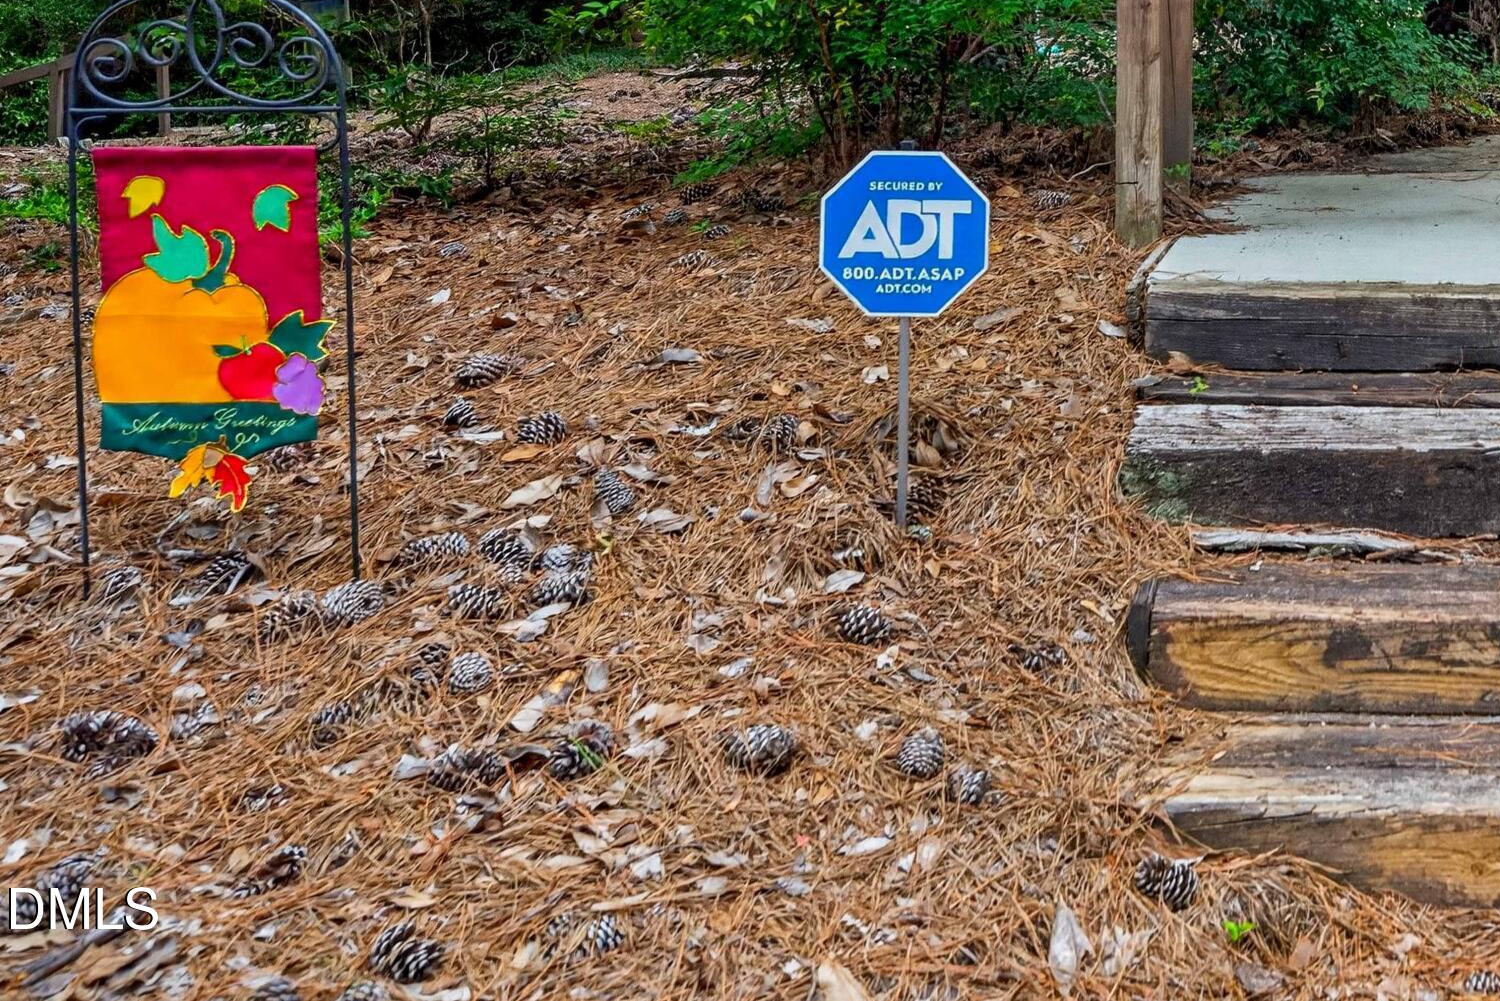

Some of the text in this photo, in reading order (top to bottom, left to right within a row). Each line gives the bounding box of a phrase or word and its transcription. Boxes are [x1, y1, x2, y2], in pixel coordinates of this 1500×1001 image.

[869, 181, 944, 191] SECURED BY
[837, 199, 972, 259] ADT
[842, 267, 965, 281] 800.ADT.ASAP
[875, 284, 932, 294] ADT.COM
[122, 408, 297, 436] Autumn Greetings
